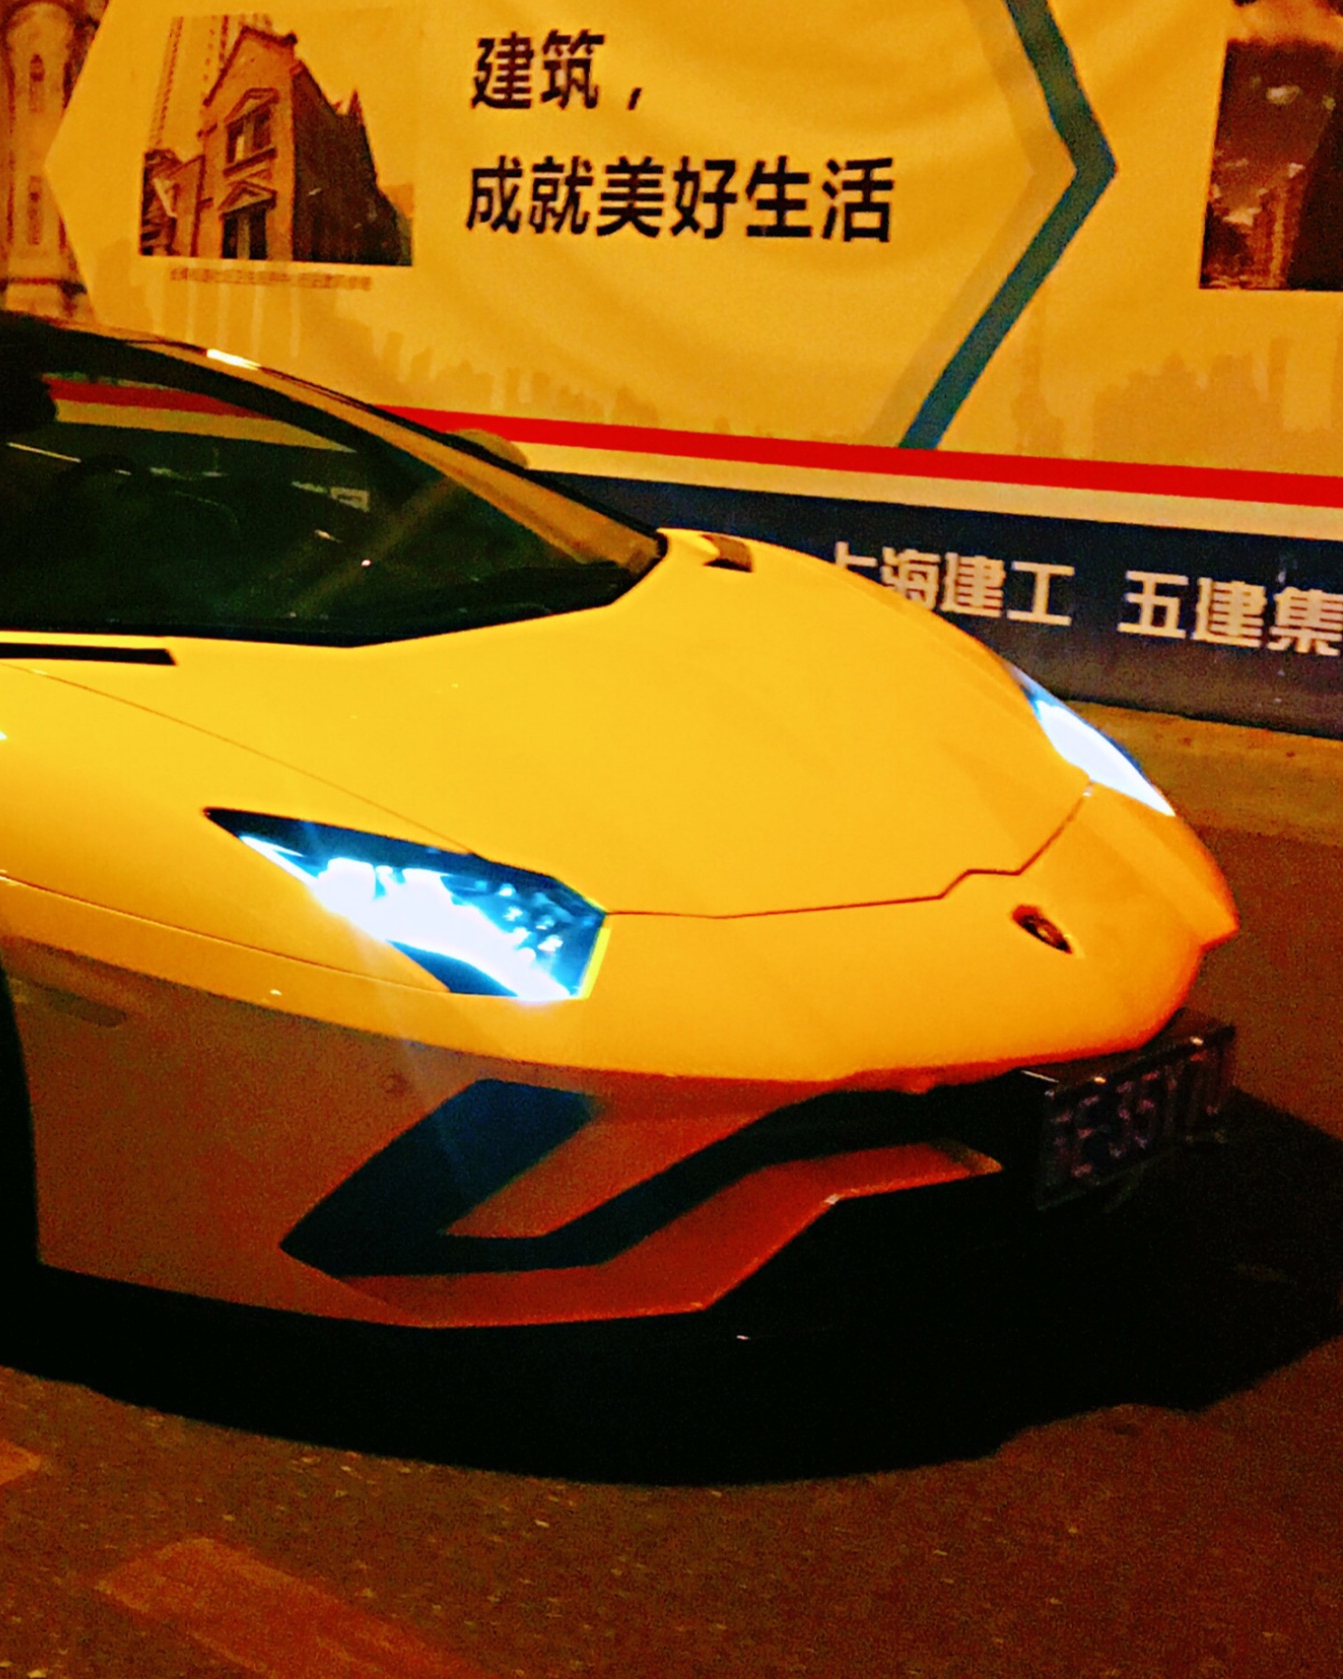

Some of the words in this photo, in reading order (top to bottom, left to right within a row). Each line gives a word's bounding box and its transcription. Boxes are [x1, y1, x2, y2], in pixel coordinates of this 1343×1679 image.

[470, 28, 643, 111] 建筑，
[465, 154, 896, 243] 成就美好生活
[1116, 569, 1343, 657] 五建集
